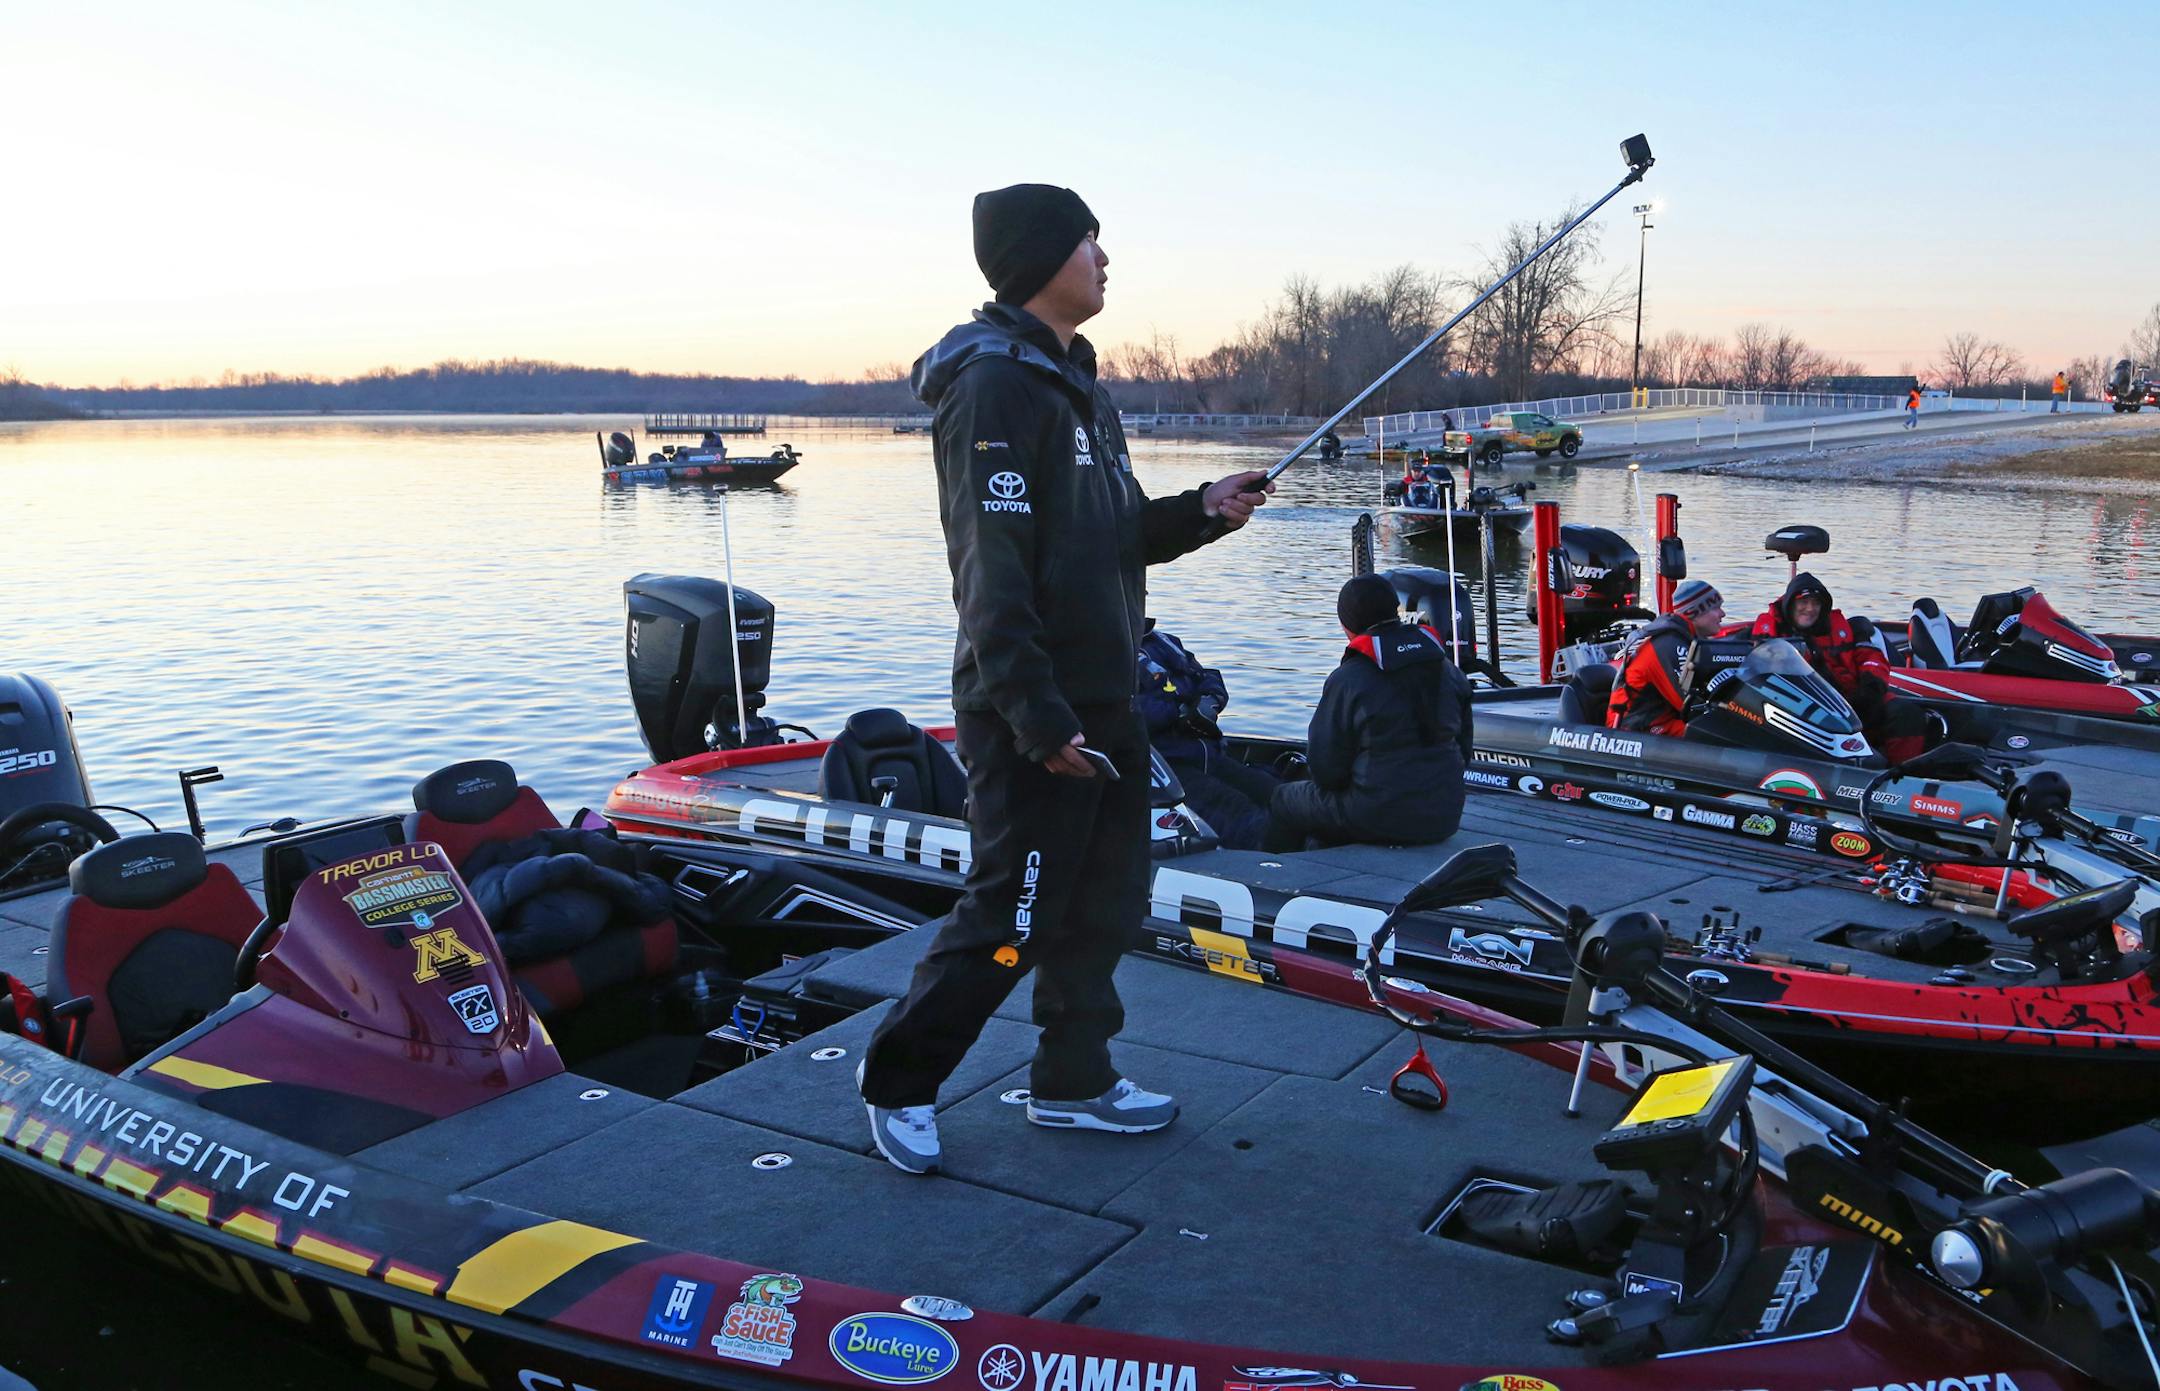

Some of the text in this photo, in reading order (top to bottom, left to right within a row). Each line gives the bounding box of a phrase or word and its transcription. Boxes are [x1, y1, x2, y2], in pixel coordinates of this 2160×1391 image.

[982, 500, 1032, 514] TOYOTA
[736, 631, 762, 641] 250
[1712, 655, 1746, 663] LOWRANCE
[1727, 701, 1764, 725] SIMMS
[1549, 727, 1643, 758] MICAH FRAZIER
[0, 750, 57, 775] 250
[1596, 792, 1643, 808] POWER-POLE
[1836, 785, 1901, 805] MERURY
[1682, 804, 1736, 829] GAMMA
[1914, 800, 1957, 816] SIMMS
[1789, 820, 1818, 837] BASS
[1837, 835, 1866, 852] ZOOM
[120, 860, 175, 878] SKEETER
[318, 843, 439, 885] TREVOR LO
[351, 874, 450, 911] BASSMASTER
[365, 892, 456, 922] COLLEGE SERIES
[1156, 936, 1276, 977] SKEETER
[452, 986, 485, 1001] SKEETER
[461, 994, 488, 1020] FX
[470, 1016, 495, 1030] 20
[40, 1077, 350, 1218] UNIVERSITY OF
[1820, 1193, 1903, 1246] minn
[1756, 1246, 1816, 1334] SKEETER
[648, 1331, 688, 1347] MARINE
[847, 1322, 940, 1364] Buckeye
[907, 1360, 934, 1373] Lures
[1031, 1351, 1197, 1391] YAMAHA
[1502, 1375, 1545, 1391] Bass
